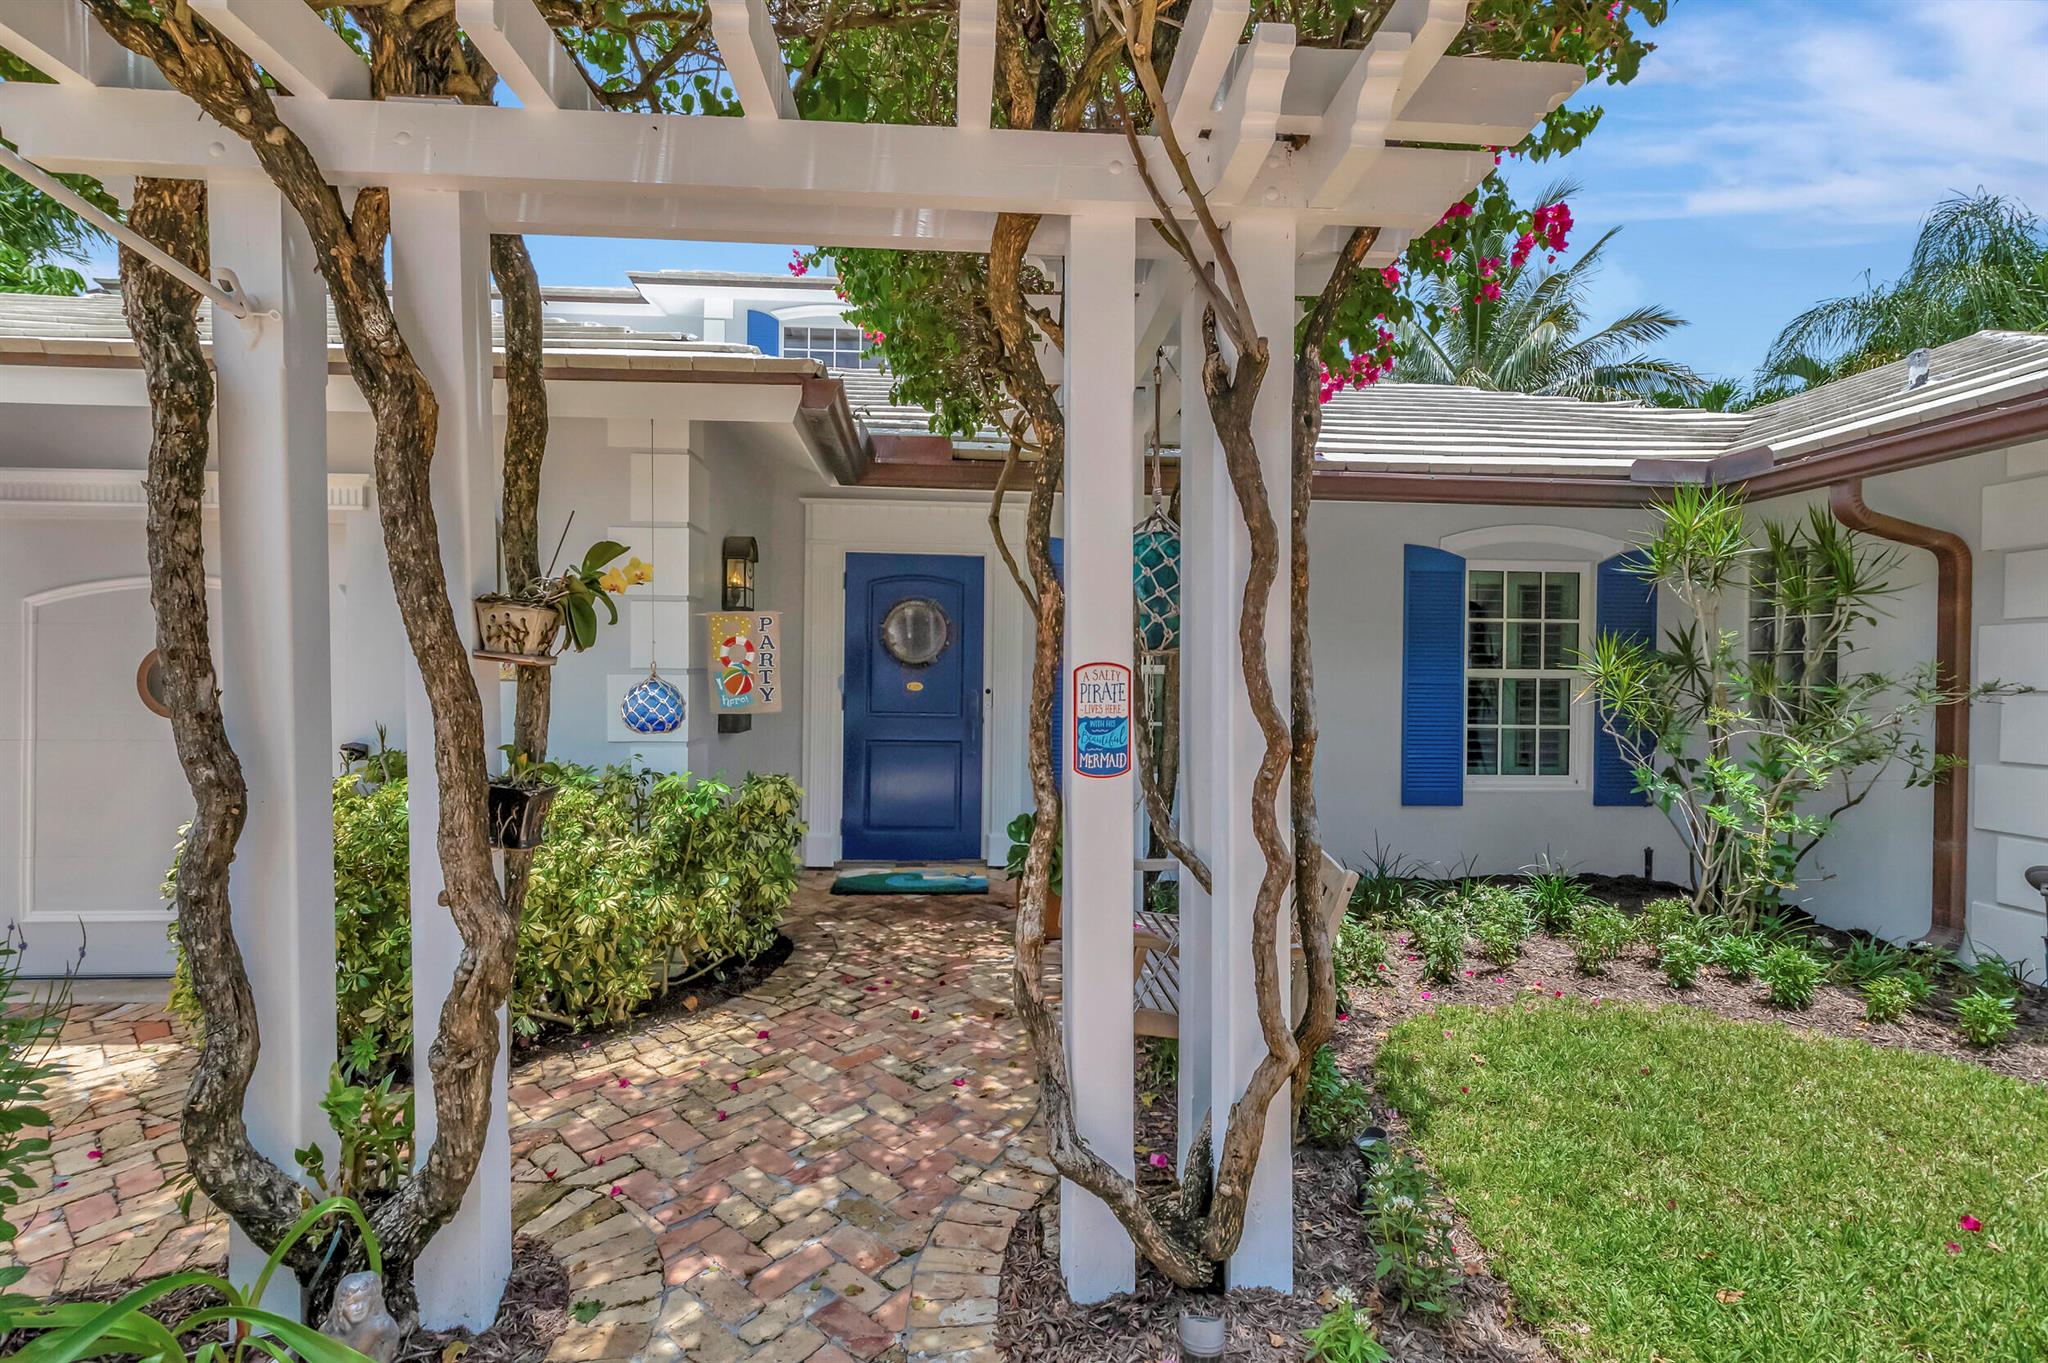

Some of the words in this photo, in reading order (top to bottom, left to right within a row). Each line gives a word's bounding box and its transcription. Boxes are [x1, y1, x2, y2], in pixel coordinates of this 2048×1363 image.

[758, 617, 775, 702] PARTY
[1083, 671, 1090, 682] A
[1092, 669, 1121, 682] SALTY
[1080, 682, 1126, 703] PIRATE
[1080, 725, 1127, 747] Beautiful
[1079, 753, 1127, 768] MERMAID
